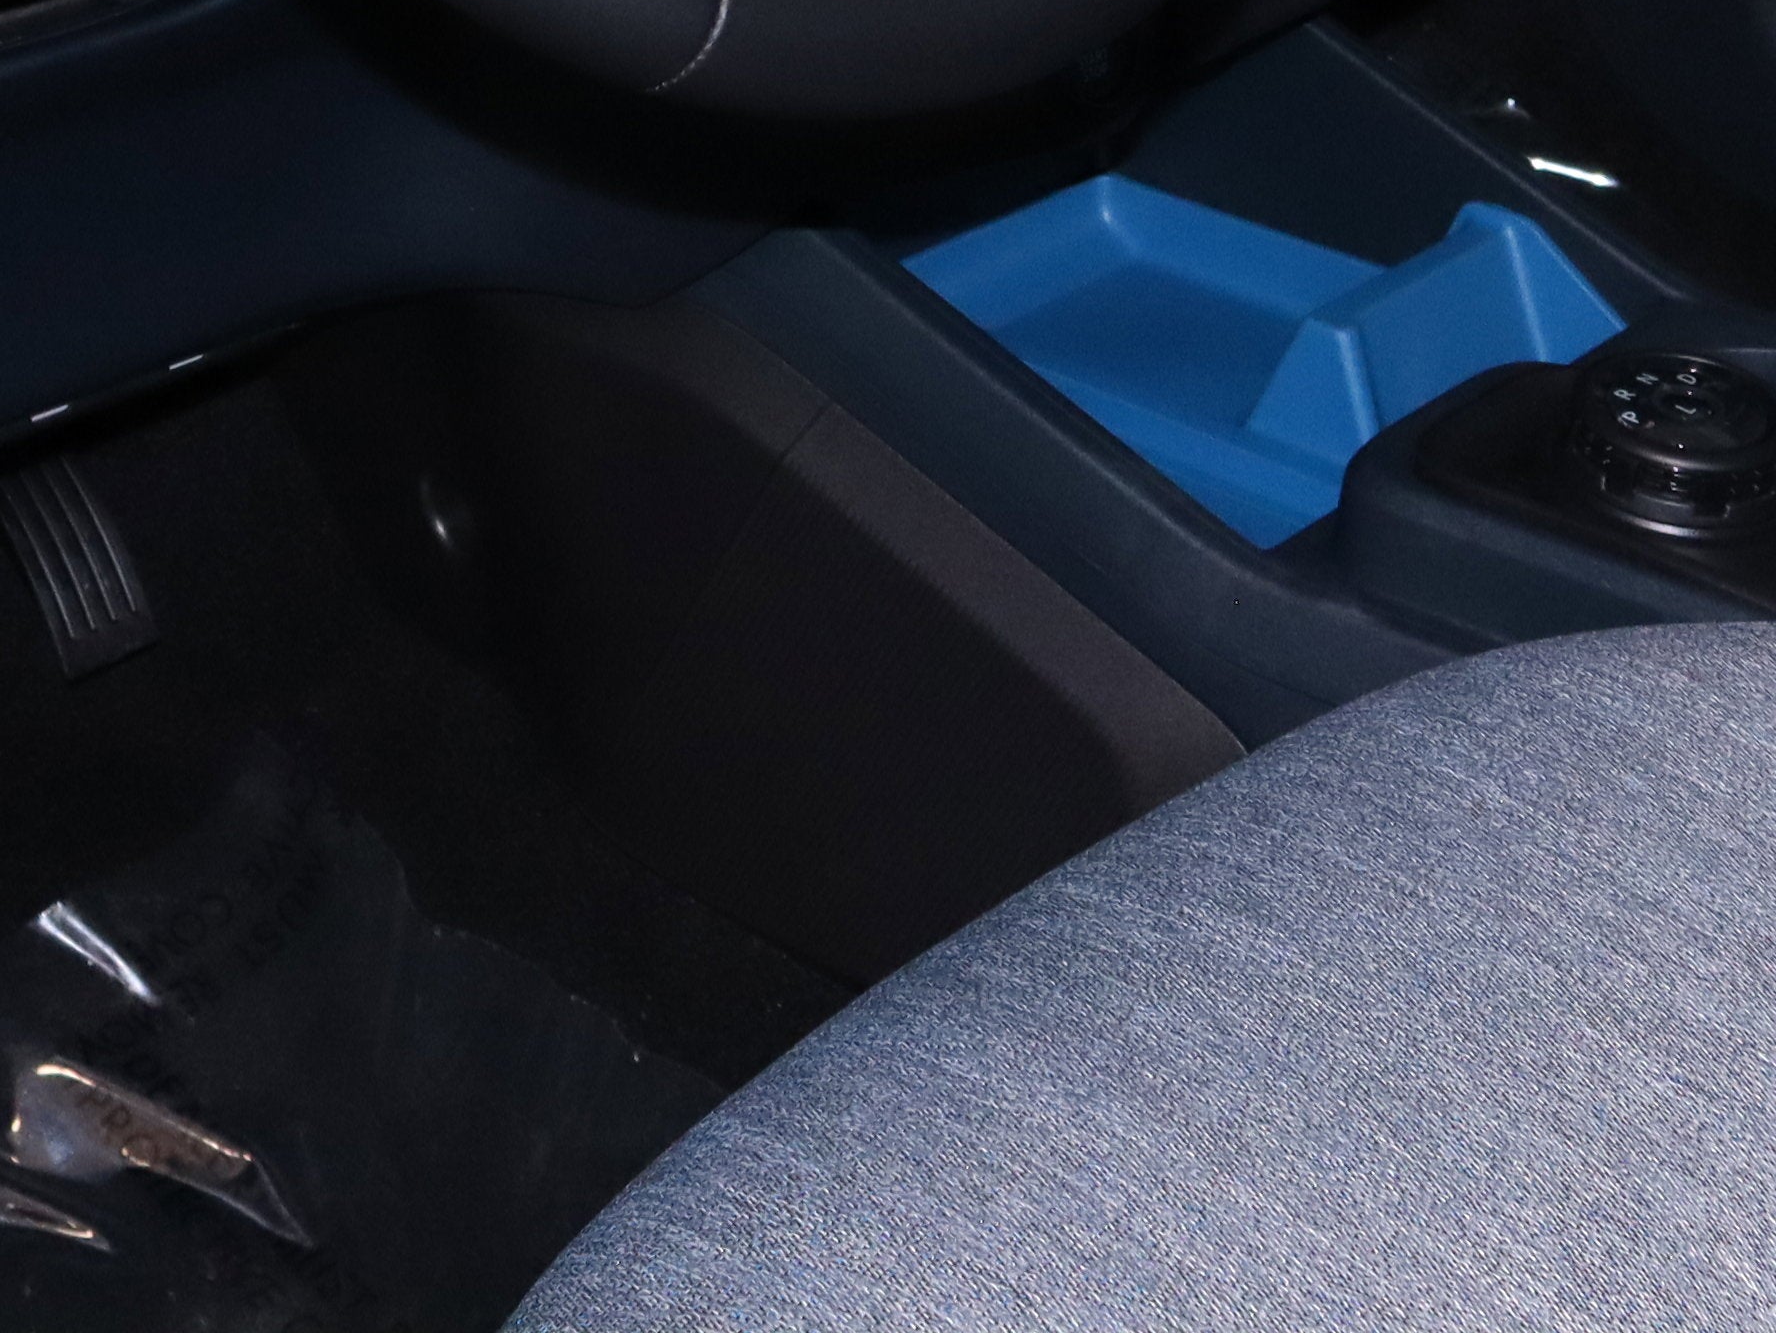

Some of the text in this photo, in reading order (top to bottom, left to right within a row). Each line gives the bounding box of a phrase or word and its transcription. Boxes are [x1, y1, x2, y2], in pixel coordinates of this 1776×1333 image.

[1613, 389, 1637, 401] R
[1635, 372, 1660, 386] N
[1676, 373, 1697, 386] D
